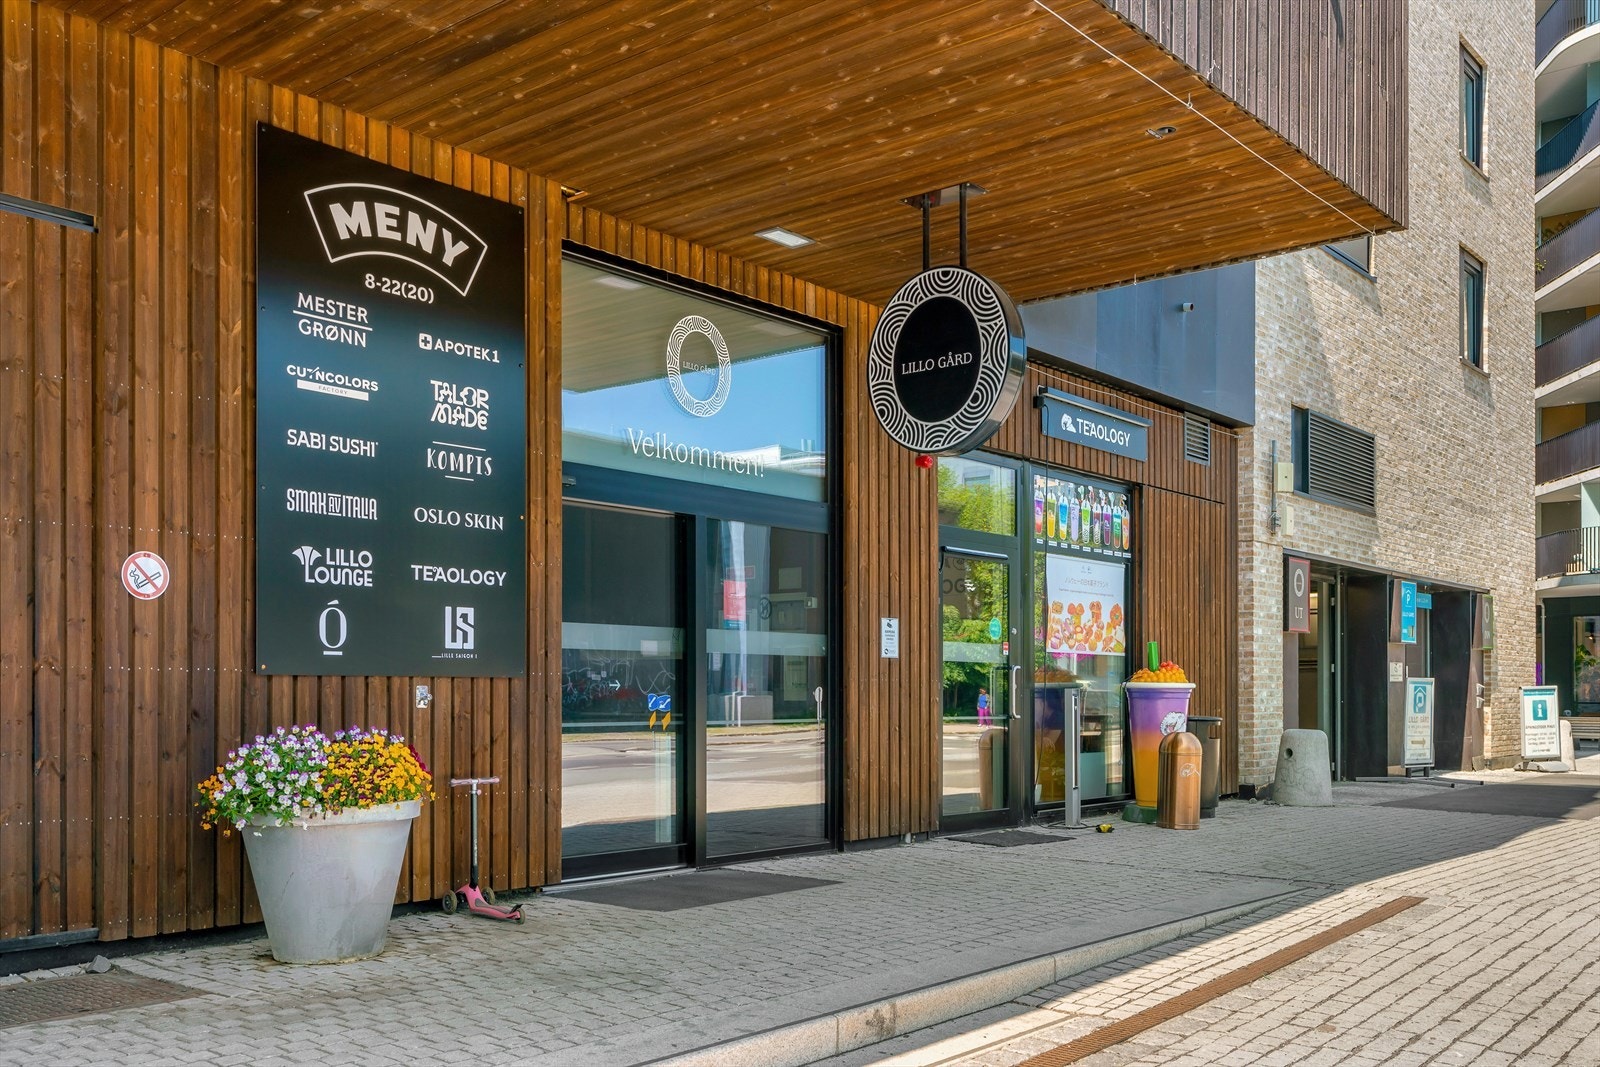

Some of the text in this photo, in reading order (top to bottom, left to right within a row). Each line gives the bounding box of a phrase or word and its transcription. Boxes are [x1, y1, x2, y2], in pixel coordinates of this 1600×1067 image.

[328, 201, 469, 267] MENY
[364, 273, 435, 304] 8-22(20)
[297, 292, 369, 324] MESTER
[298, 319, 367, 348] GRØNN
[902, 351, 973, 375] LILLO GÅRD
[318, 385, 348, 396] FACTORY
[287, 428, 377, 458] SABI SUSHI
[1076, 418, 1131, 448] TEAOLOGY
[427, 447, 492, 476] KOMPIS
[627, 427, 765, 478] Velkommen!
[286, 488, 377, 521] SMAK AV ITALIA
[414, 507, 504, 531] OSLO SKIN
[326, 547, 373, 568] LILLO
[305, 563, 373, 587] LOUNGE
[410, 564, 507, 587] TEAOLOGY
[1294, 606, 1304, 619] UT
